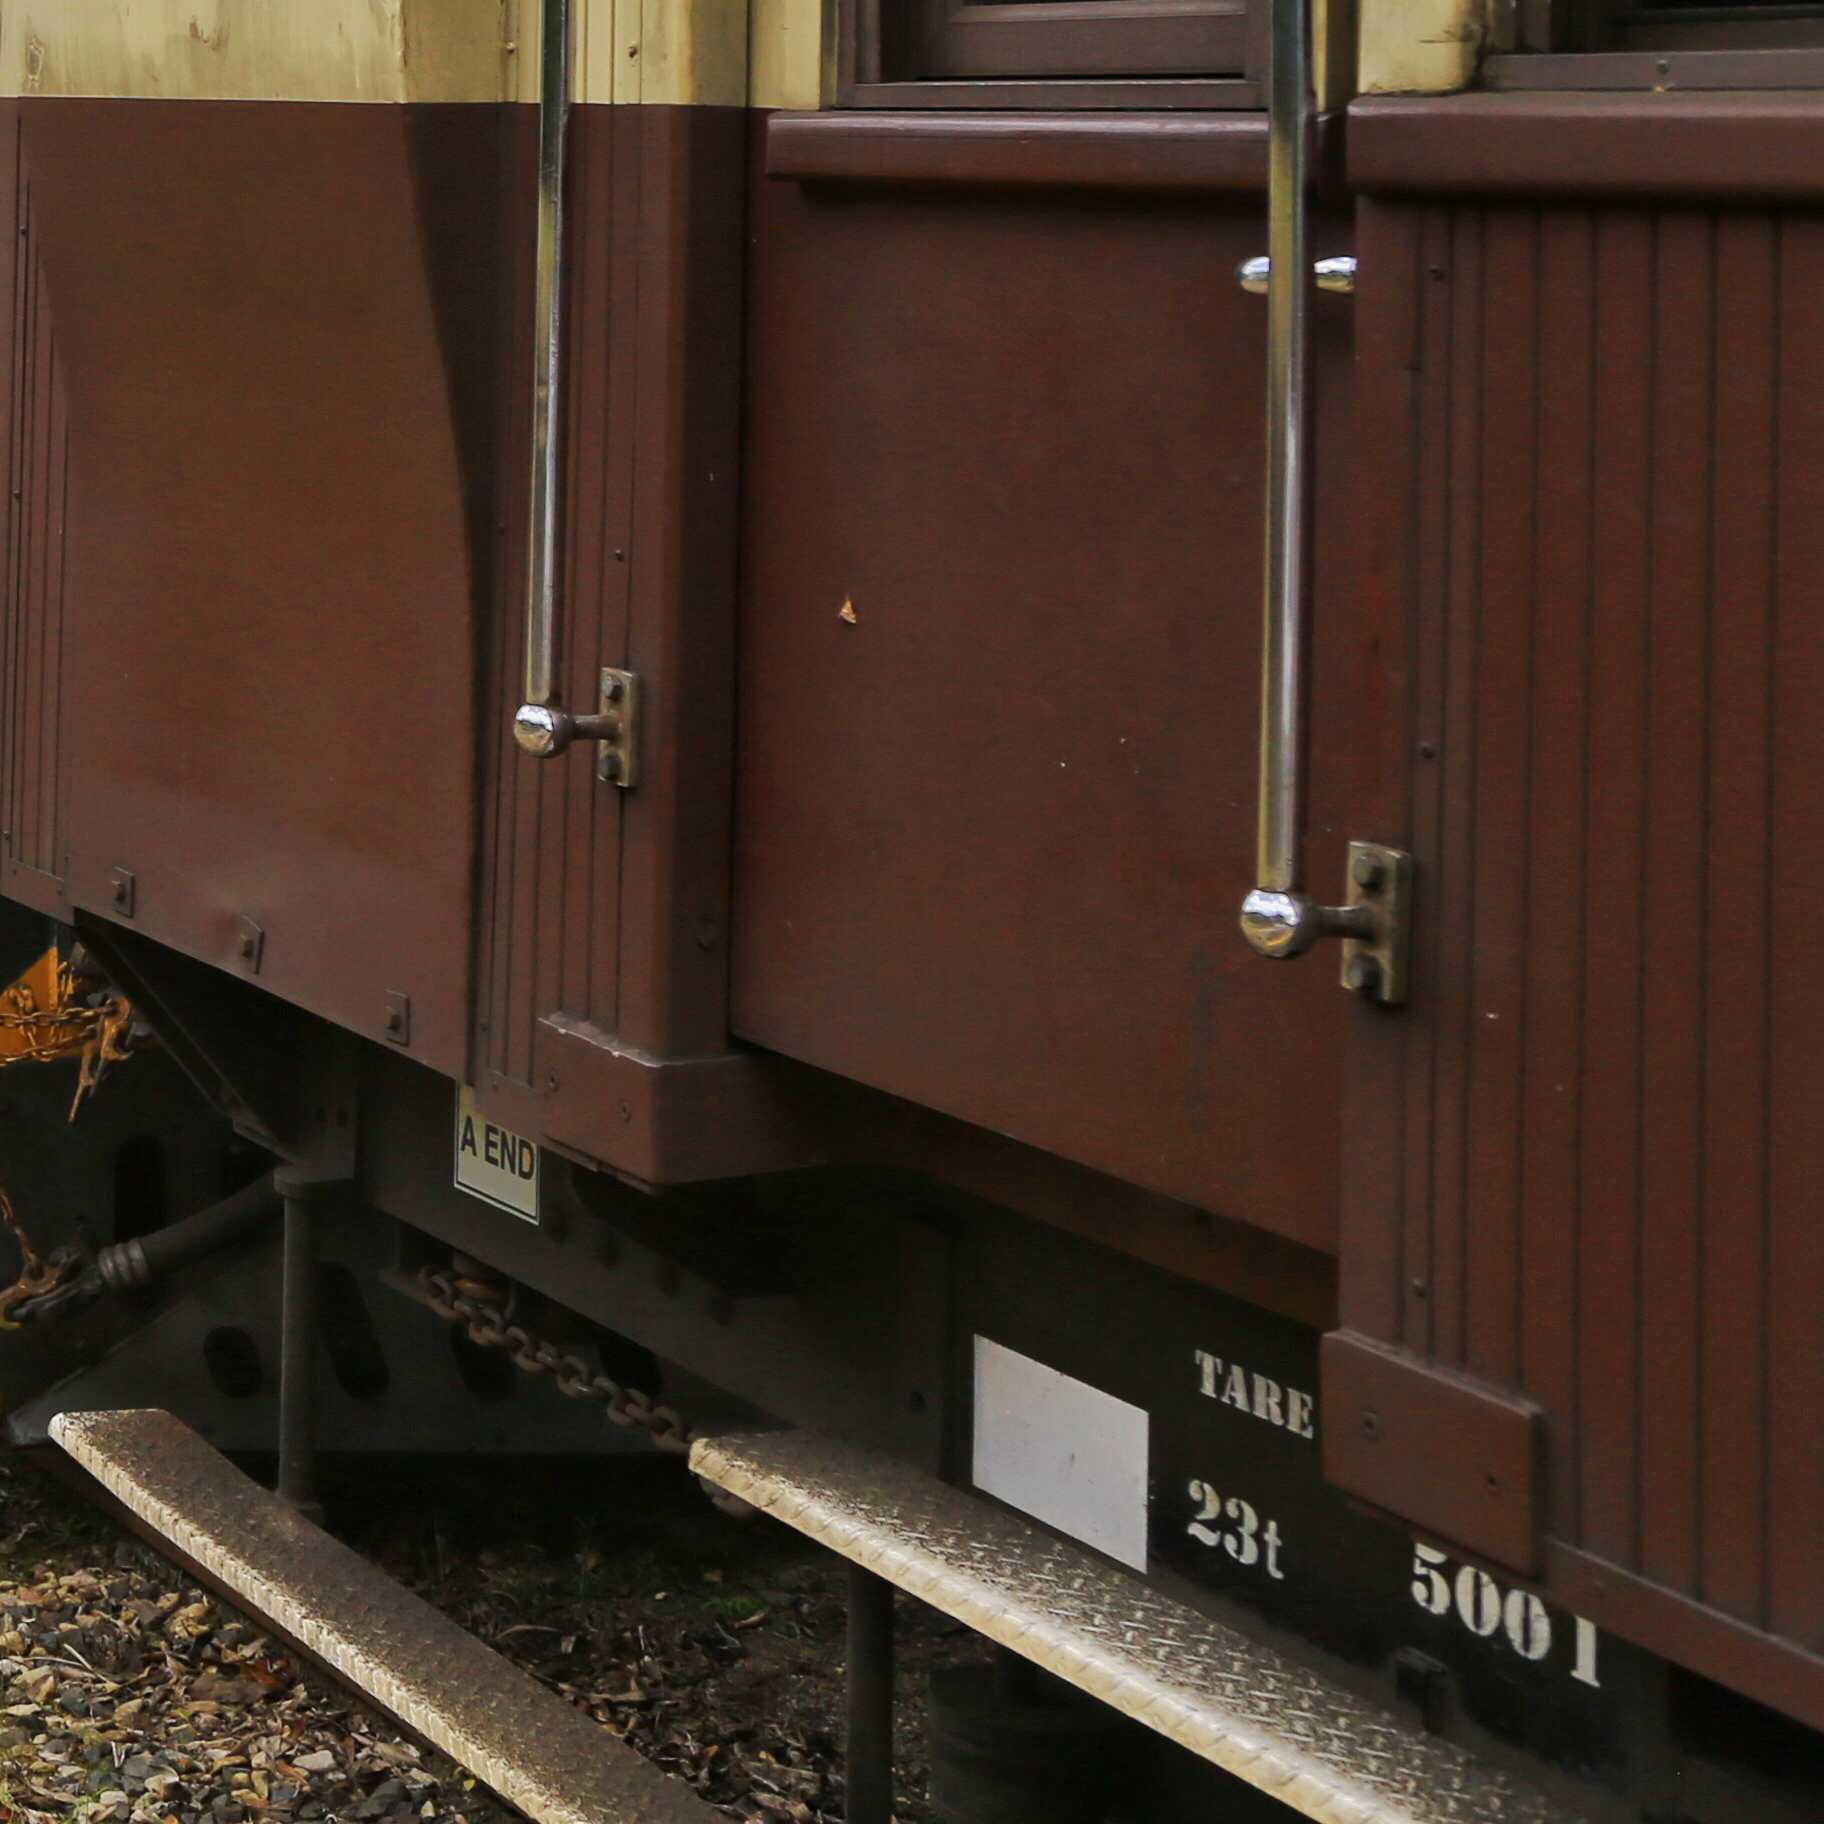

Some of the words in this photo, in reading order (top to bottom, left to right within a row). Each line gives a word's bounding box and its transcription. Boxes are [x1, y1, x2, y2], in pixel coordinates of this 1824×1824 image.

[460, 1115, 478, 1157] A
[485, 1124, 535, 1180] END
[1194, 1348, 1313, 1440] TARE
[1187, 1479, 1283, 1579] 23t
[1411, 1542, 1602, 1688] 5001
